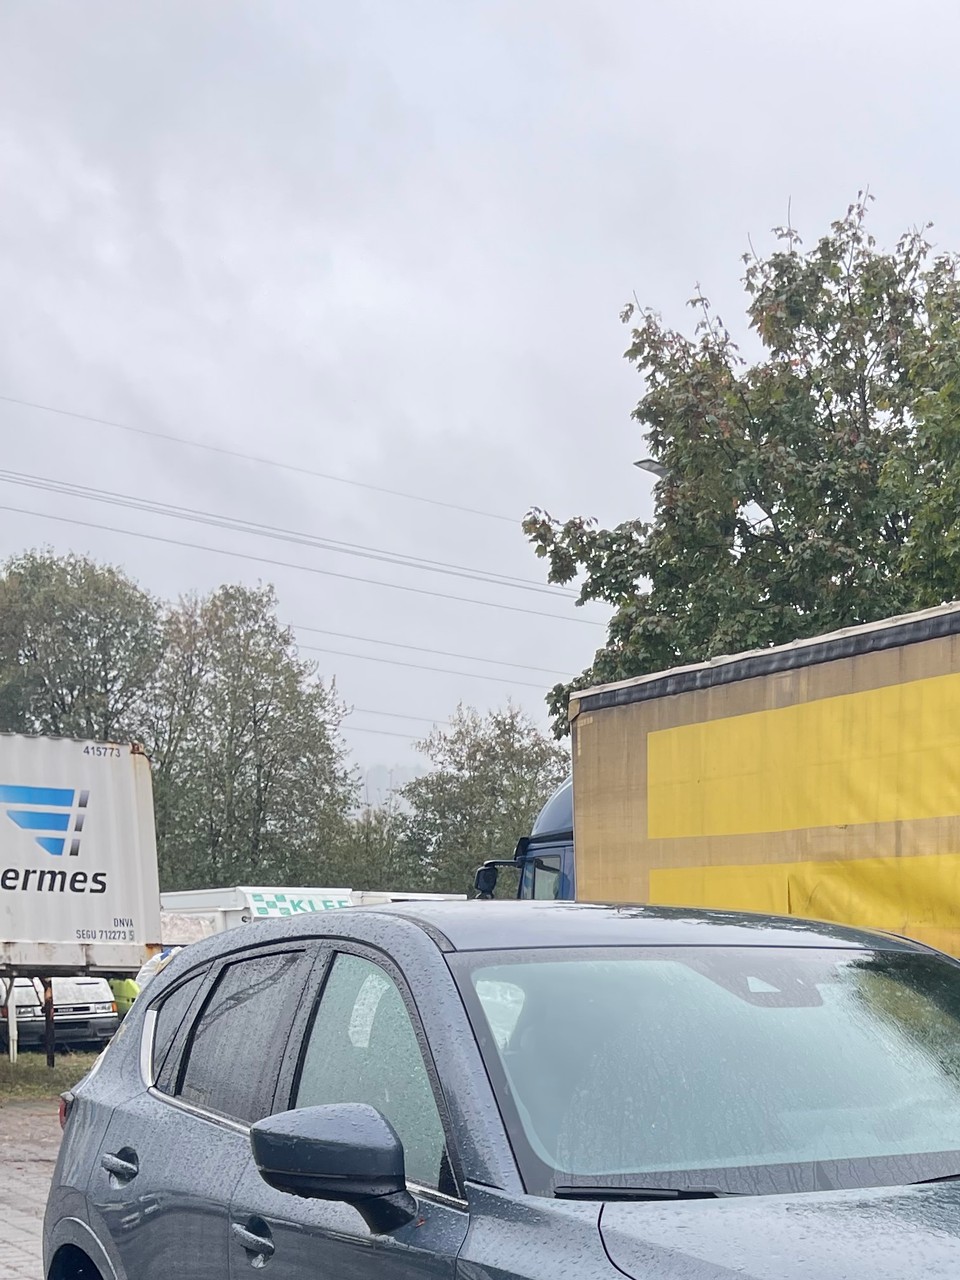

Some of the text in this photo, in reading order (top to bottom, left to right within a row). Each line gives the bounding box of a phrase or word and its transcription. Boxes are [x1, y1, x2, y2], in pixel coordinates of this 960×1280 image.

[83, 745, 121, 758] 415773
[76, 929, 97, 940] SEGU
[98, 930, 127, 940] 712273
